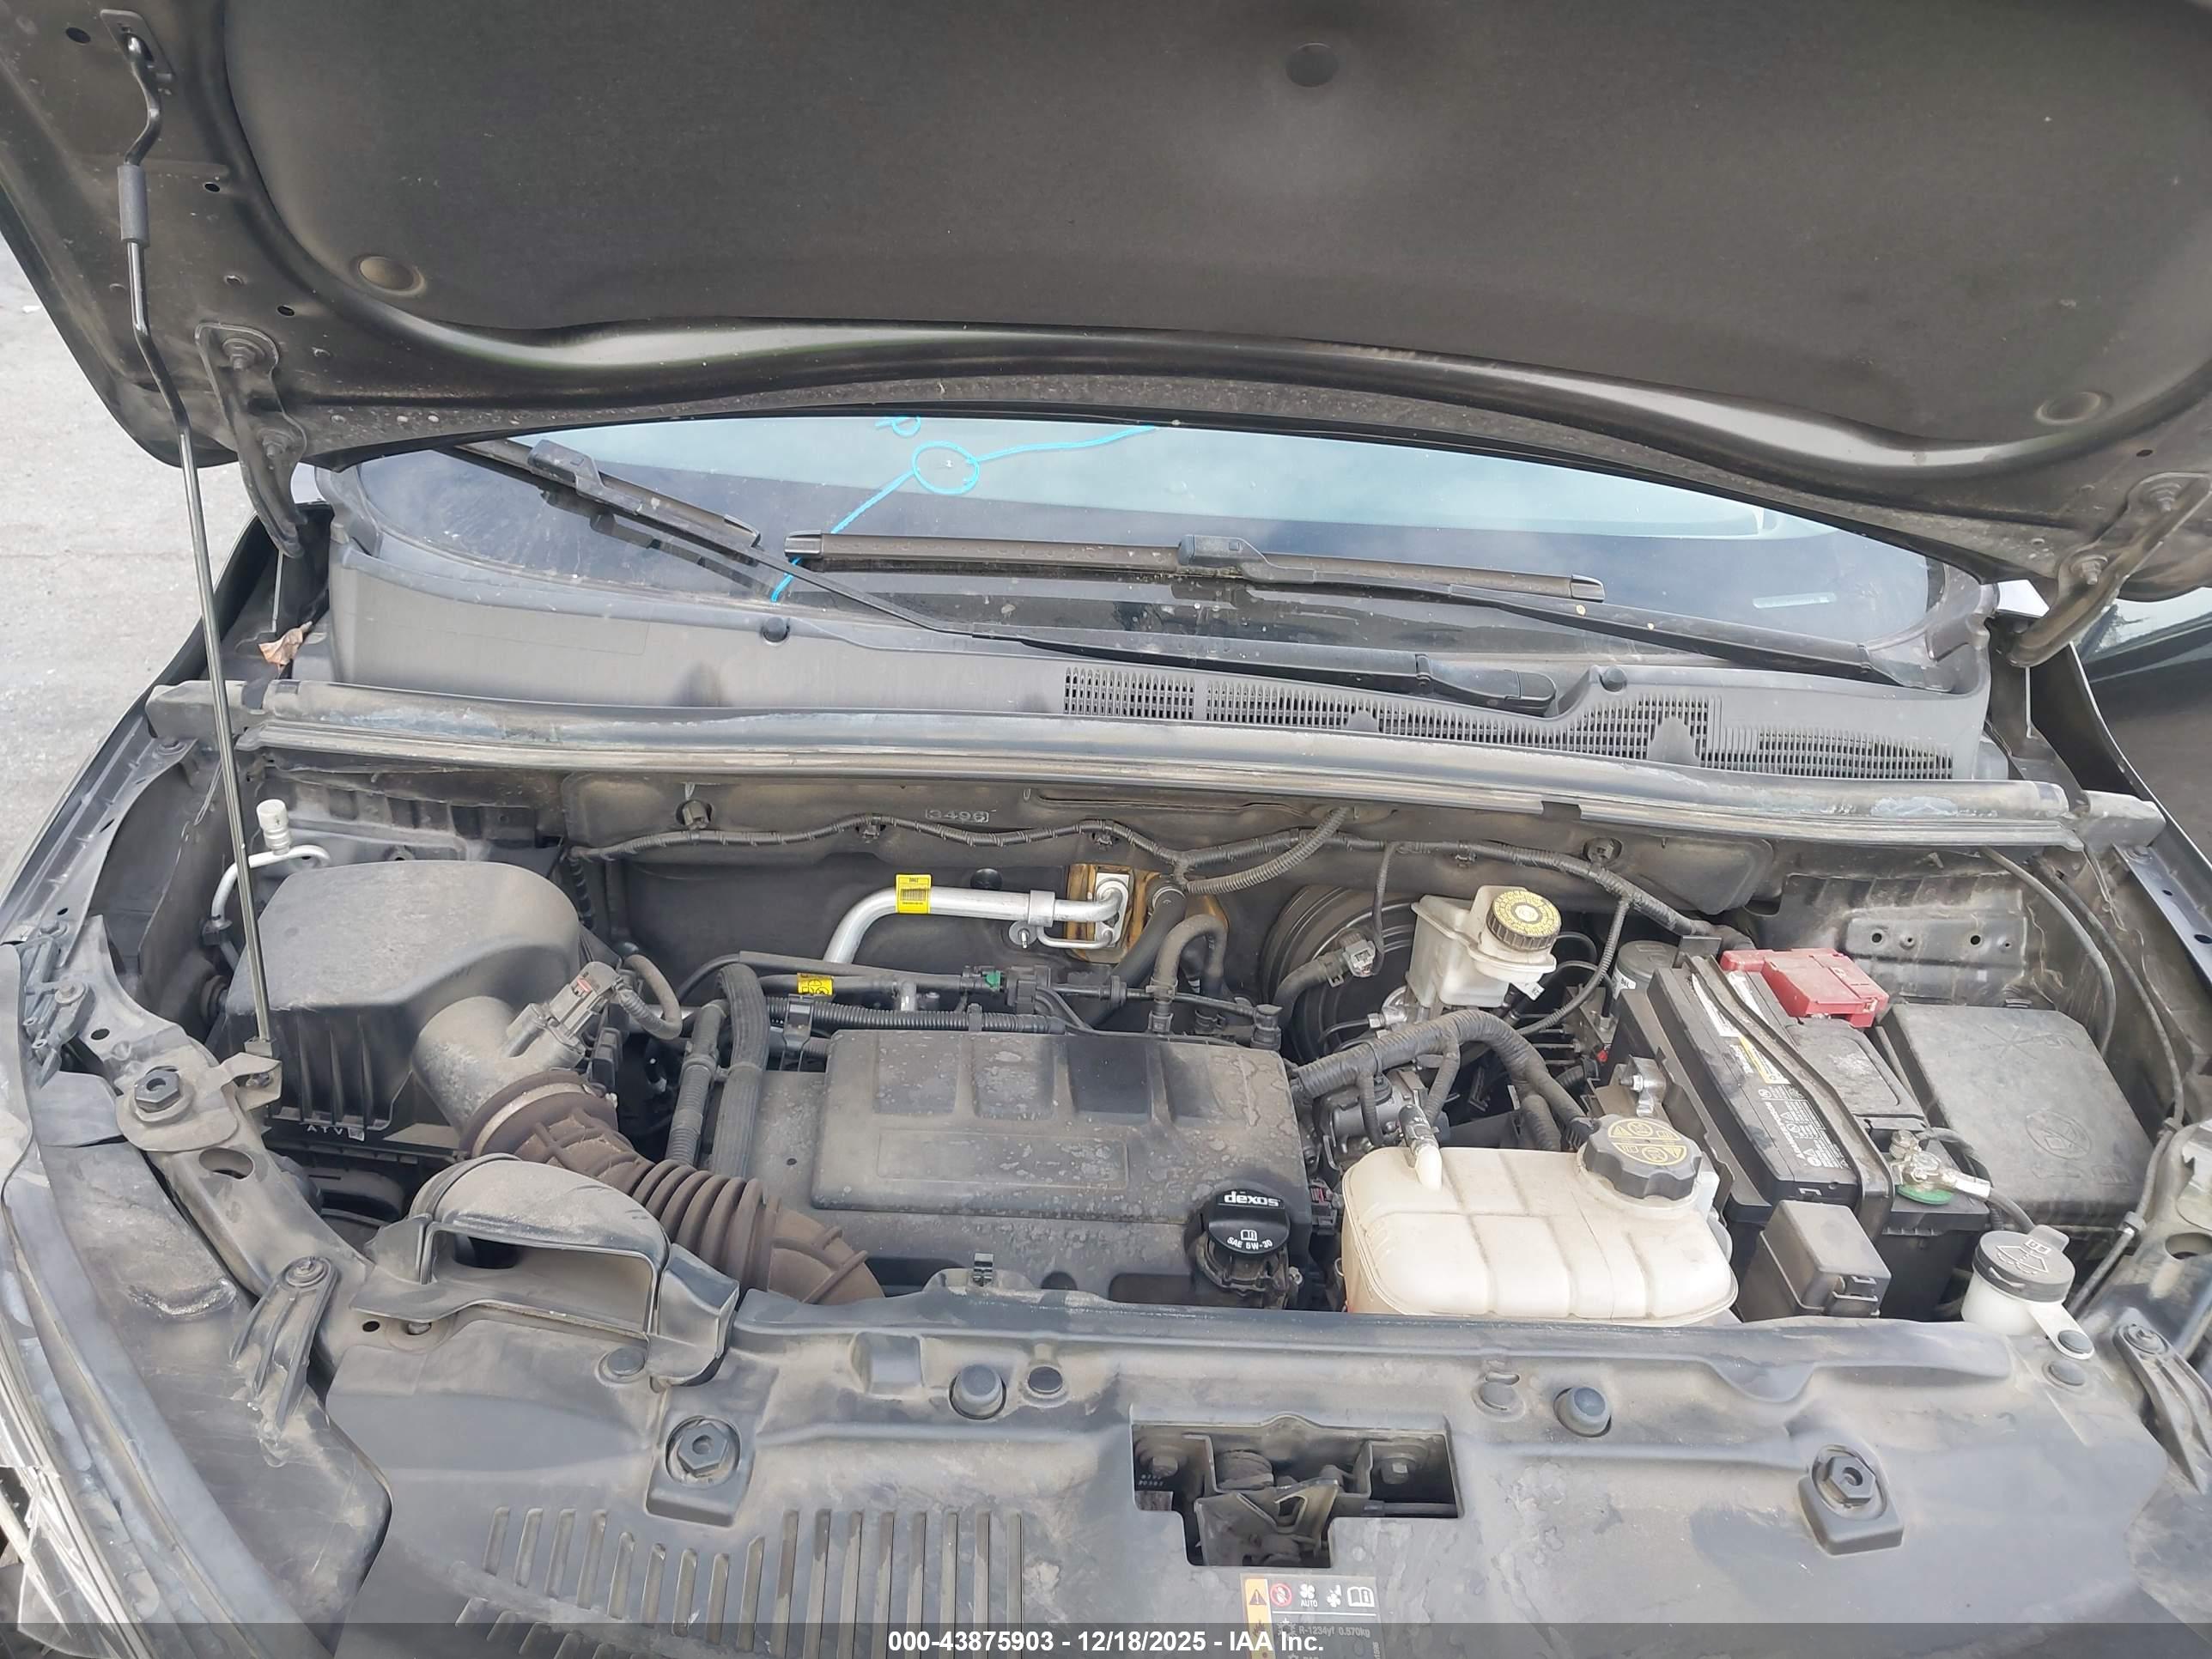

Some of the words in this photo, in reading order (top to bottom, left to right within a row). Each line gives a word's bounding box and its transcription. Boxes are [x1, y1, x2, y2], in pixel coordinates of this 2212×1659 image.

[1227, 1237, 1243, 1249] SAE
[1245, 1239, 1273, 1250] 5W-30
[1298, 1625, 1335, 1637] R-1234yf
